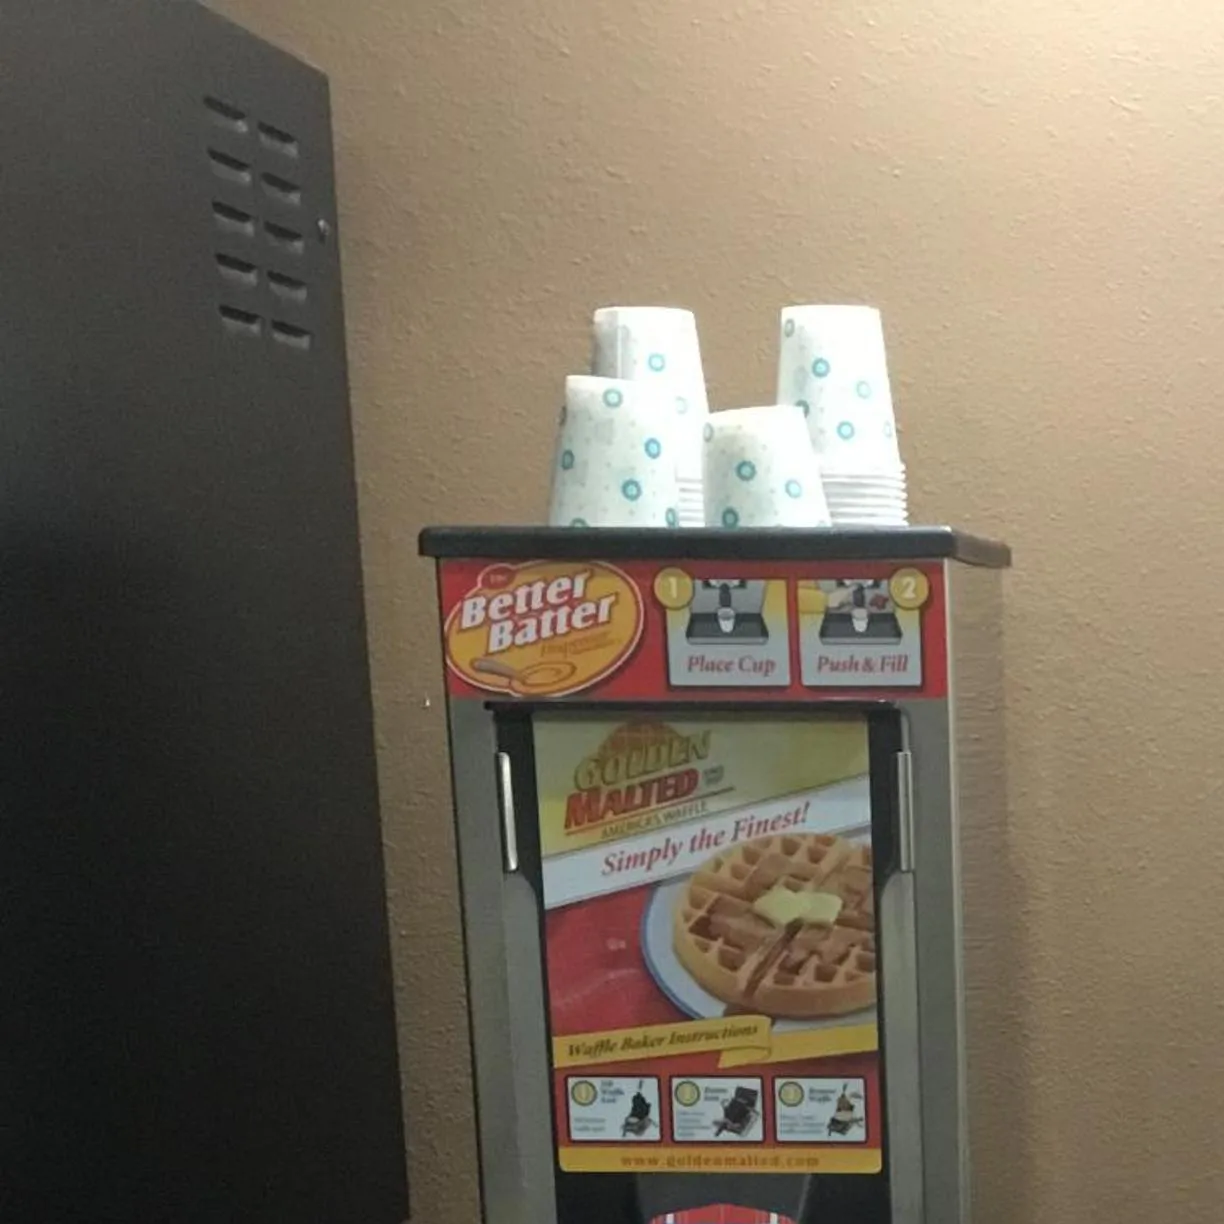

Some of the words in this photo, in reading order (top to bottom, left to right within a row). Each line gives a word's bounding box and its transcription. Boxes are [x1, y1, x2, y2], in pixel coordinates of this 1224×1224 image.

[461, 570, 592, 630] Better
[668, 577, 678, 598] 1
[901, 577, 917, 599] 2
[489, 594, 617, 653] Batter
[687, 655, 733, 673] Place
[738, 655, 776, 677] Cup
[817, 655, 859, 673] Push
[861, 656, 876, 672] &
[880, 654, 908, 673] Fill
[574, 730, 712, 791] GOLDEN
[564, 768, 699, 830] MALTED
[601, 838, 683, 875] Simply
[690, 827, 725, 854] the
[731, 801, 810, 843] Finest!
[568, 1037, 617, 1058] Waffle
[621, 1031, 665, 1050] Baker
[668, 1024, 758, 1046] Instructions
